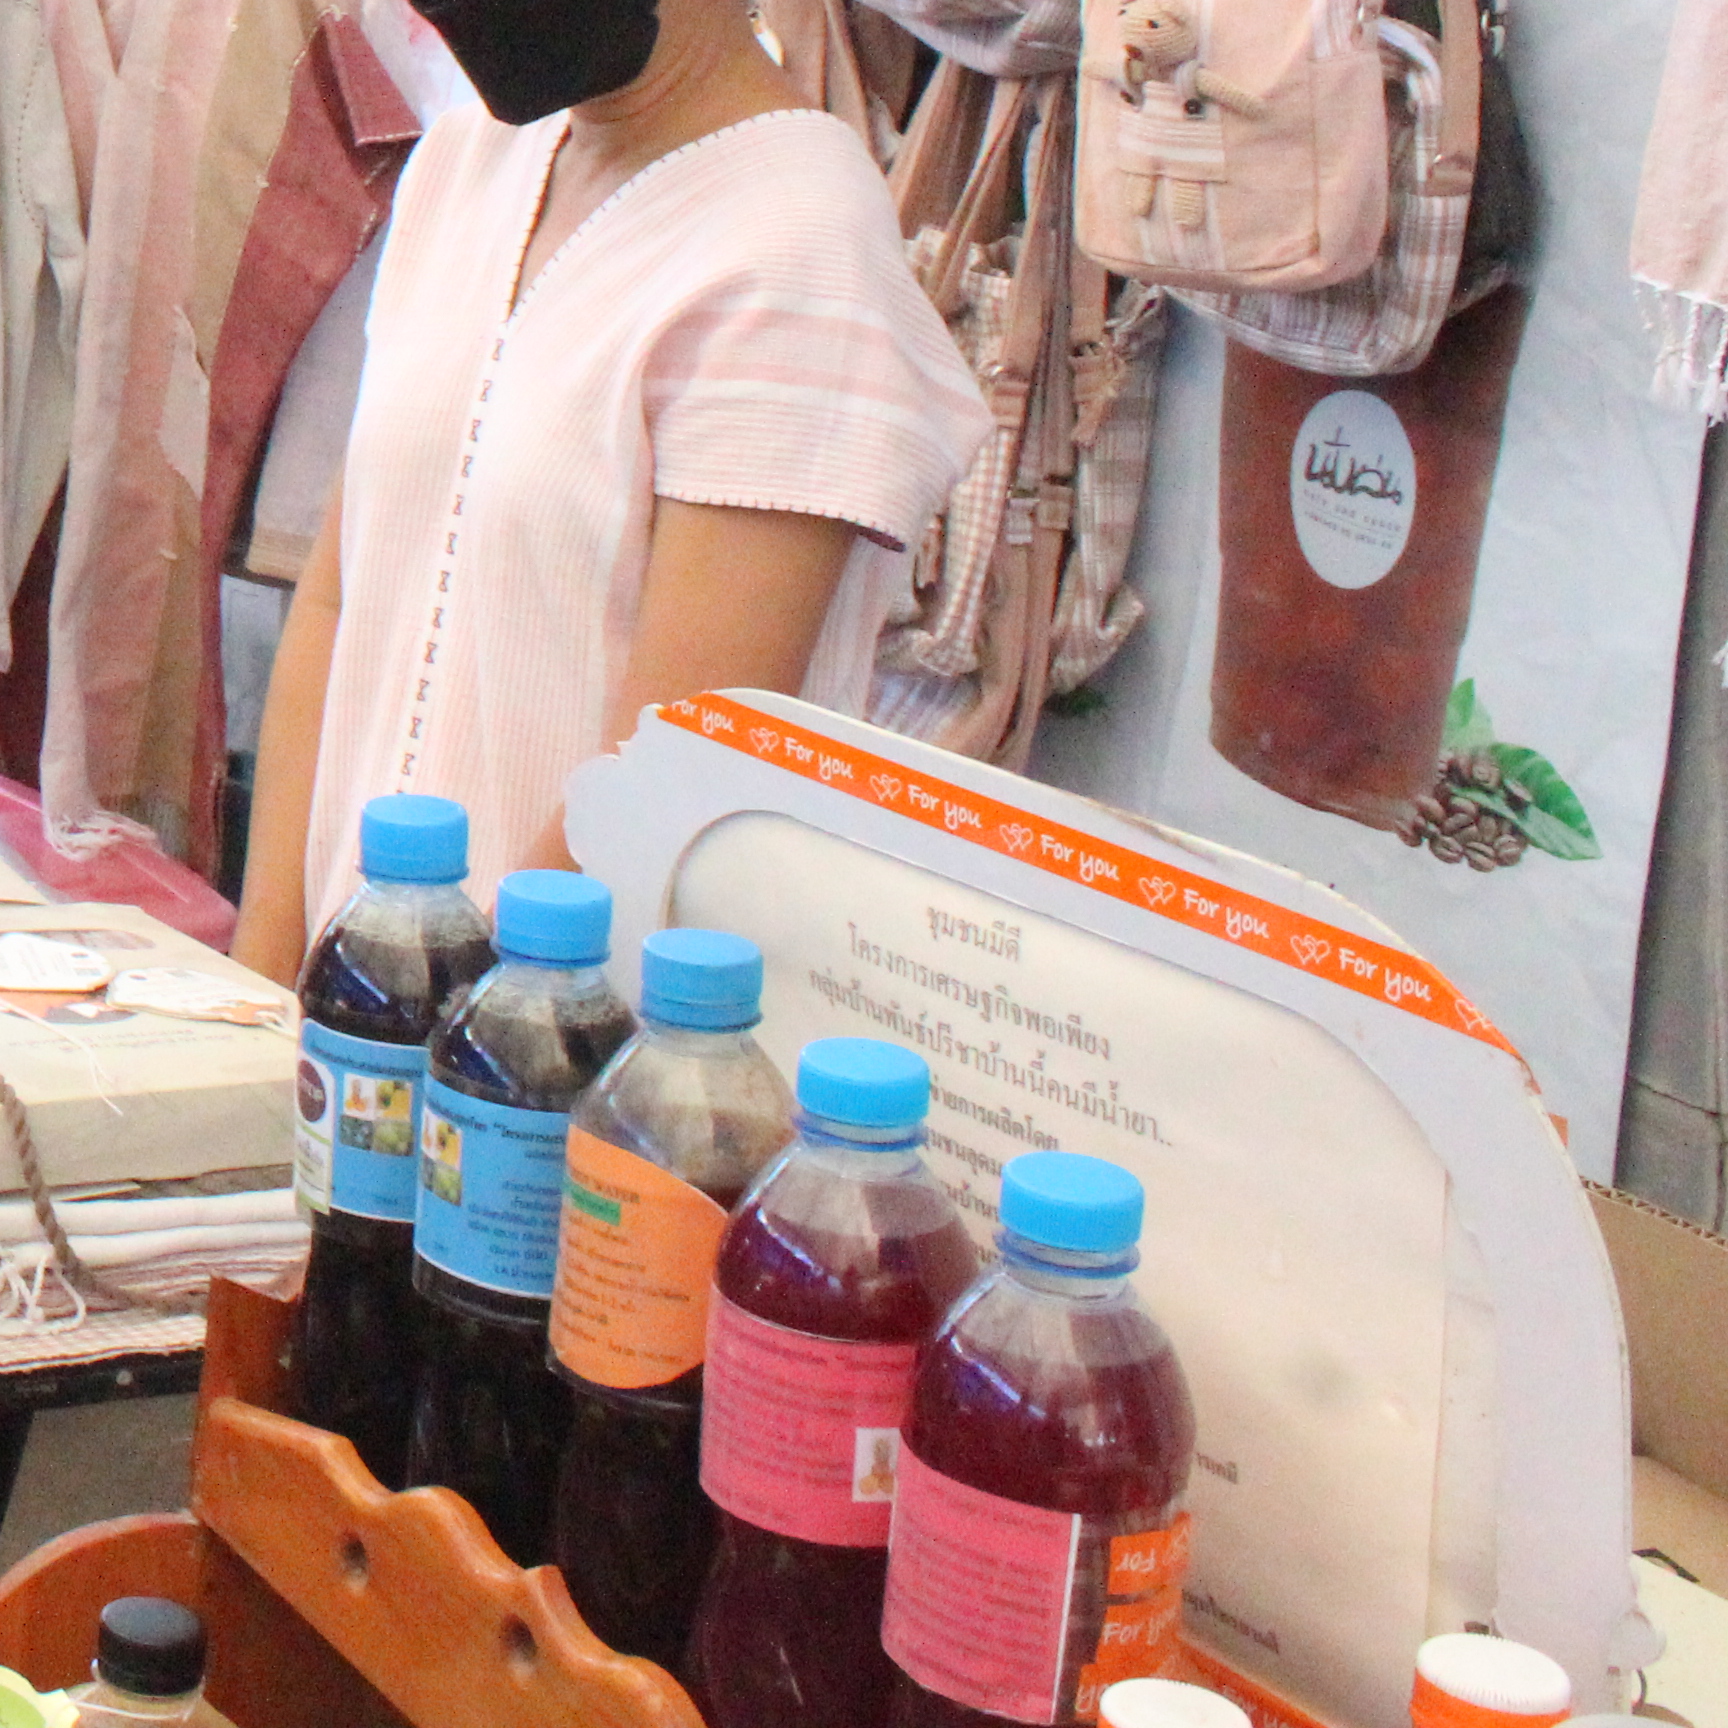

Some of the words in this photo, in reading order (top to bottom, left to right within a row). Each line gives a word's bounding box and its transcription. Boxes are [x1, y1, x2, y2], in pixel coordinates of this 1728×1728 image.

[702, 707, 735, 734] you
[784, 737, 815, 764] For
[819, 752, 853, 780] you
[907, 784, 940, 812] For
[944, 800, 982, 830] you
[1039, 833, 1076, 863] For
[1078, 850, 1120, 883] you
[1183, 888, 1221, 919] For
[1225, 906, 1270, 940] you
[1338, 947, 1378, 980] For
[1384, 967, 1432, 1003] you
[846, 920, 1111, 1062] โครงการเศรษฐกิจพอเพียง
[927, 906, 1022, 962] ชุมชนมีดี
